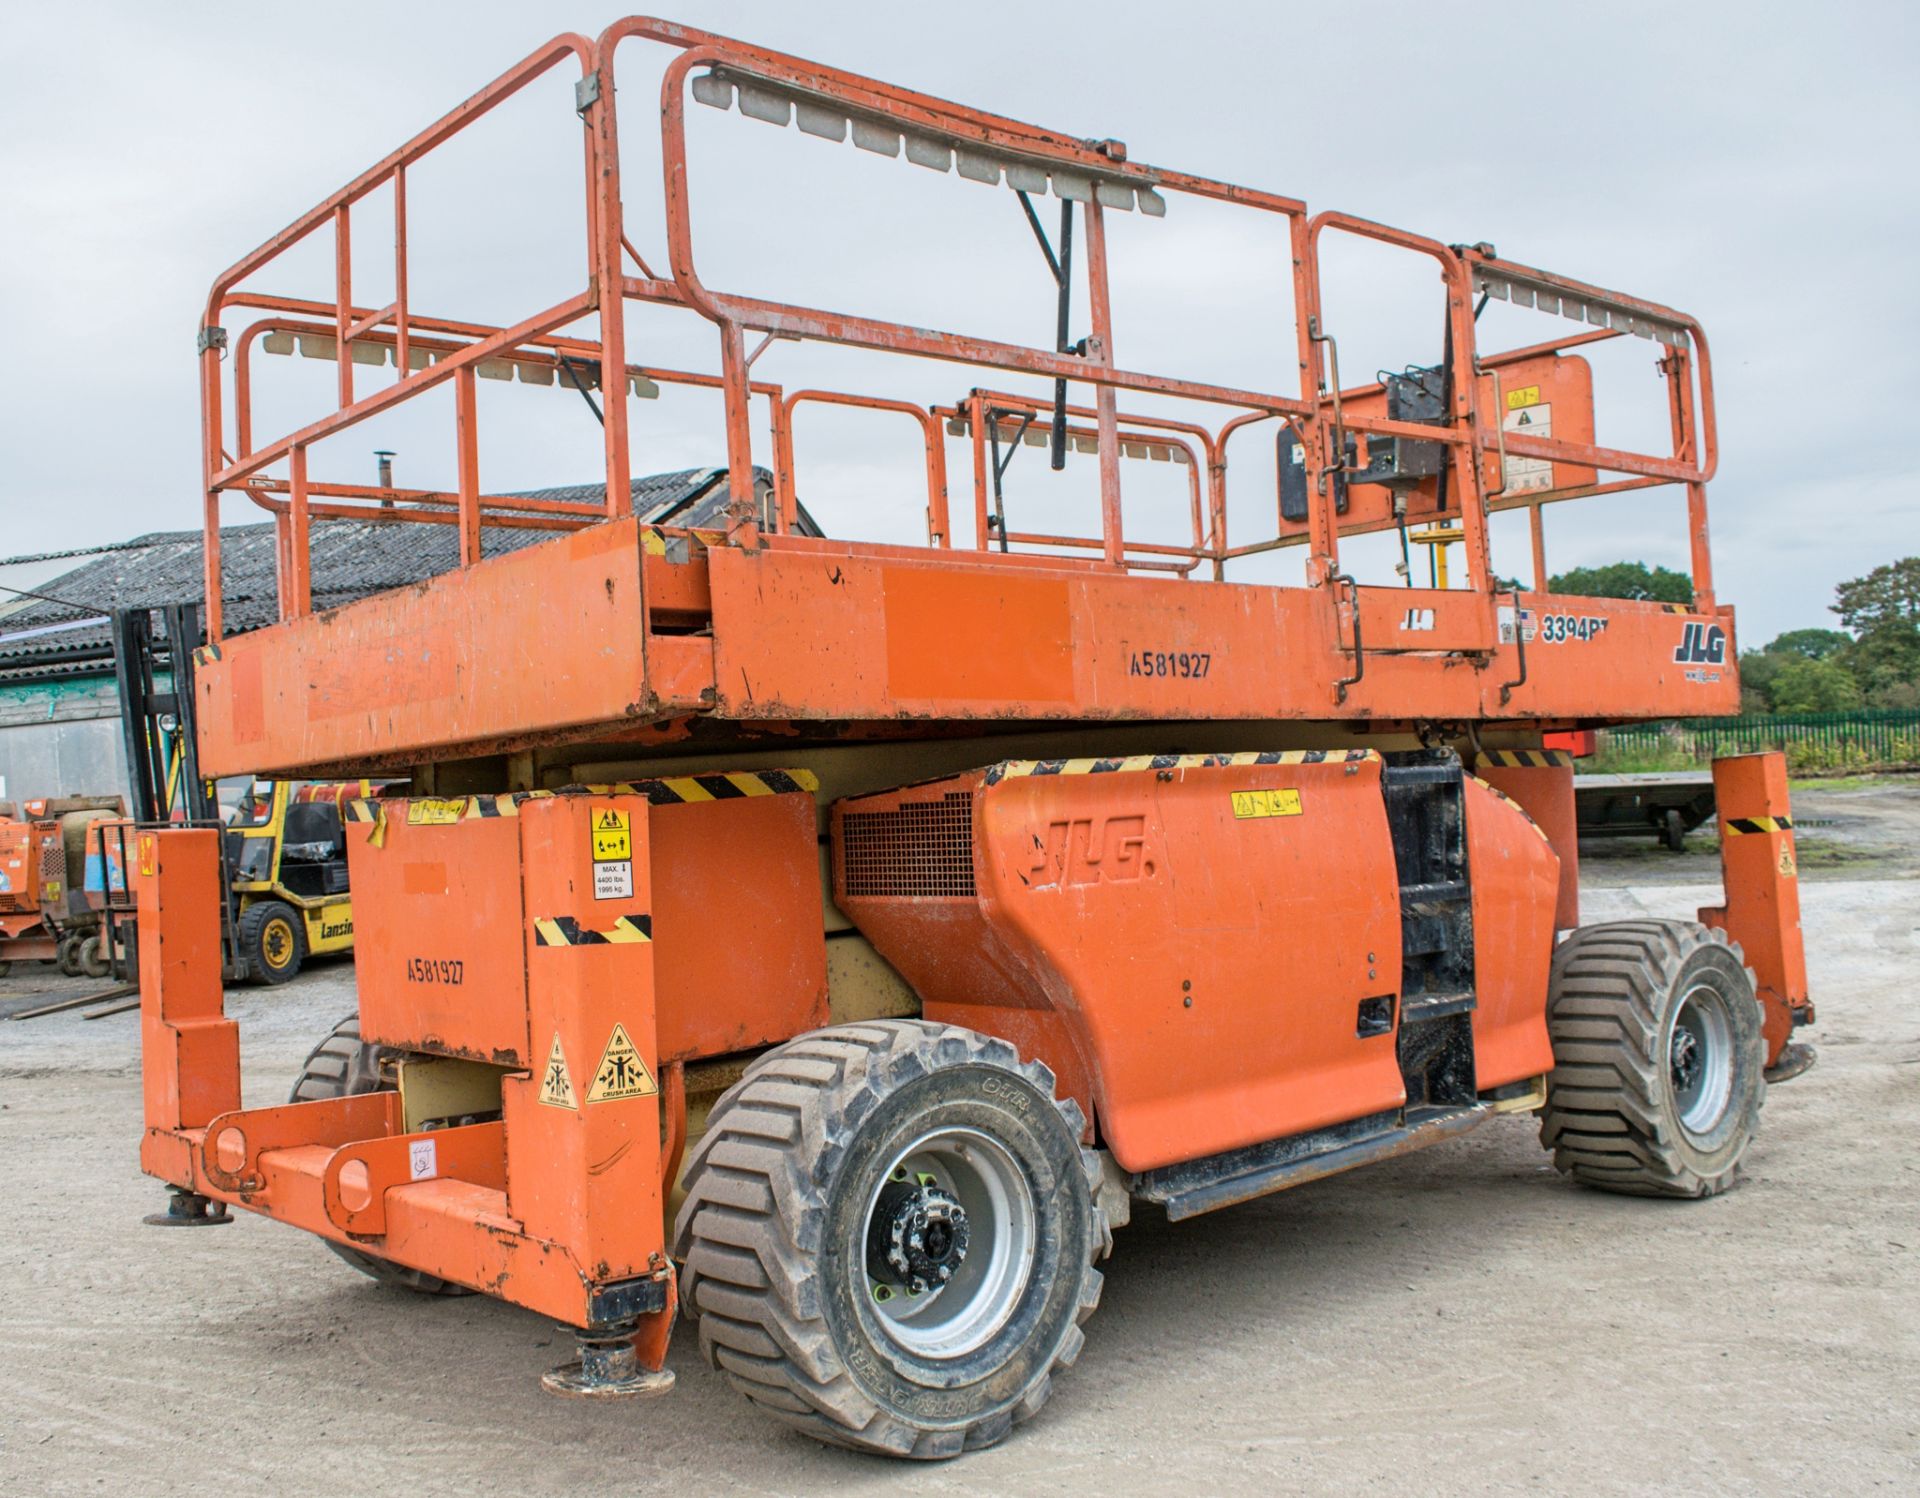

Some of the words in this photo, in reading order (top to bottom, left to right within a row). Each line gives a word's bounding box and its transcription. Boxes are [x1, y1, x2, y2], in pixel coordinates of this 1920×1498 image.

[1673, 622, 1726, 665] JLG
[1130, 651, 1211, 678] A581927
[1028, 815, 1147, 891] JLG
[407, 958, 464, 985] A581927
[607, 1048, 633, 1056] DANGER
[602, 1089, 624, 1097] CRUSH
[625, 1087, 642, 1095] AREA
[982, 1077, 1031, 1112] OTR
